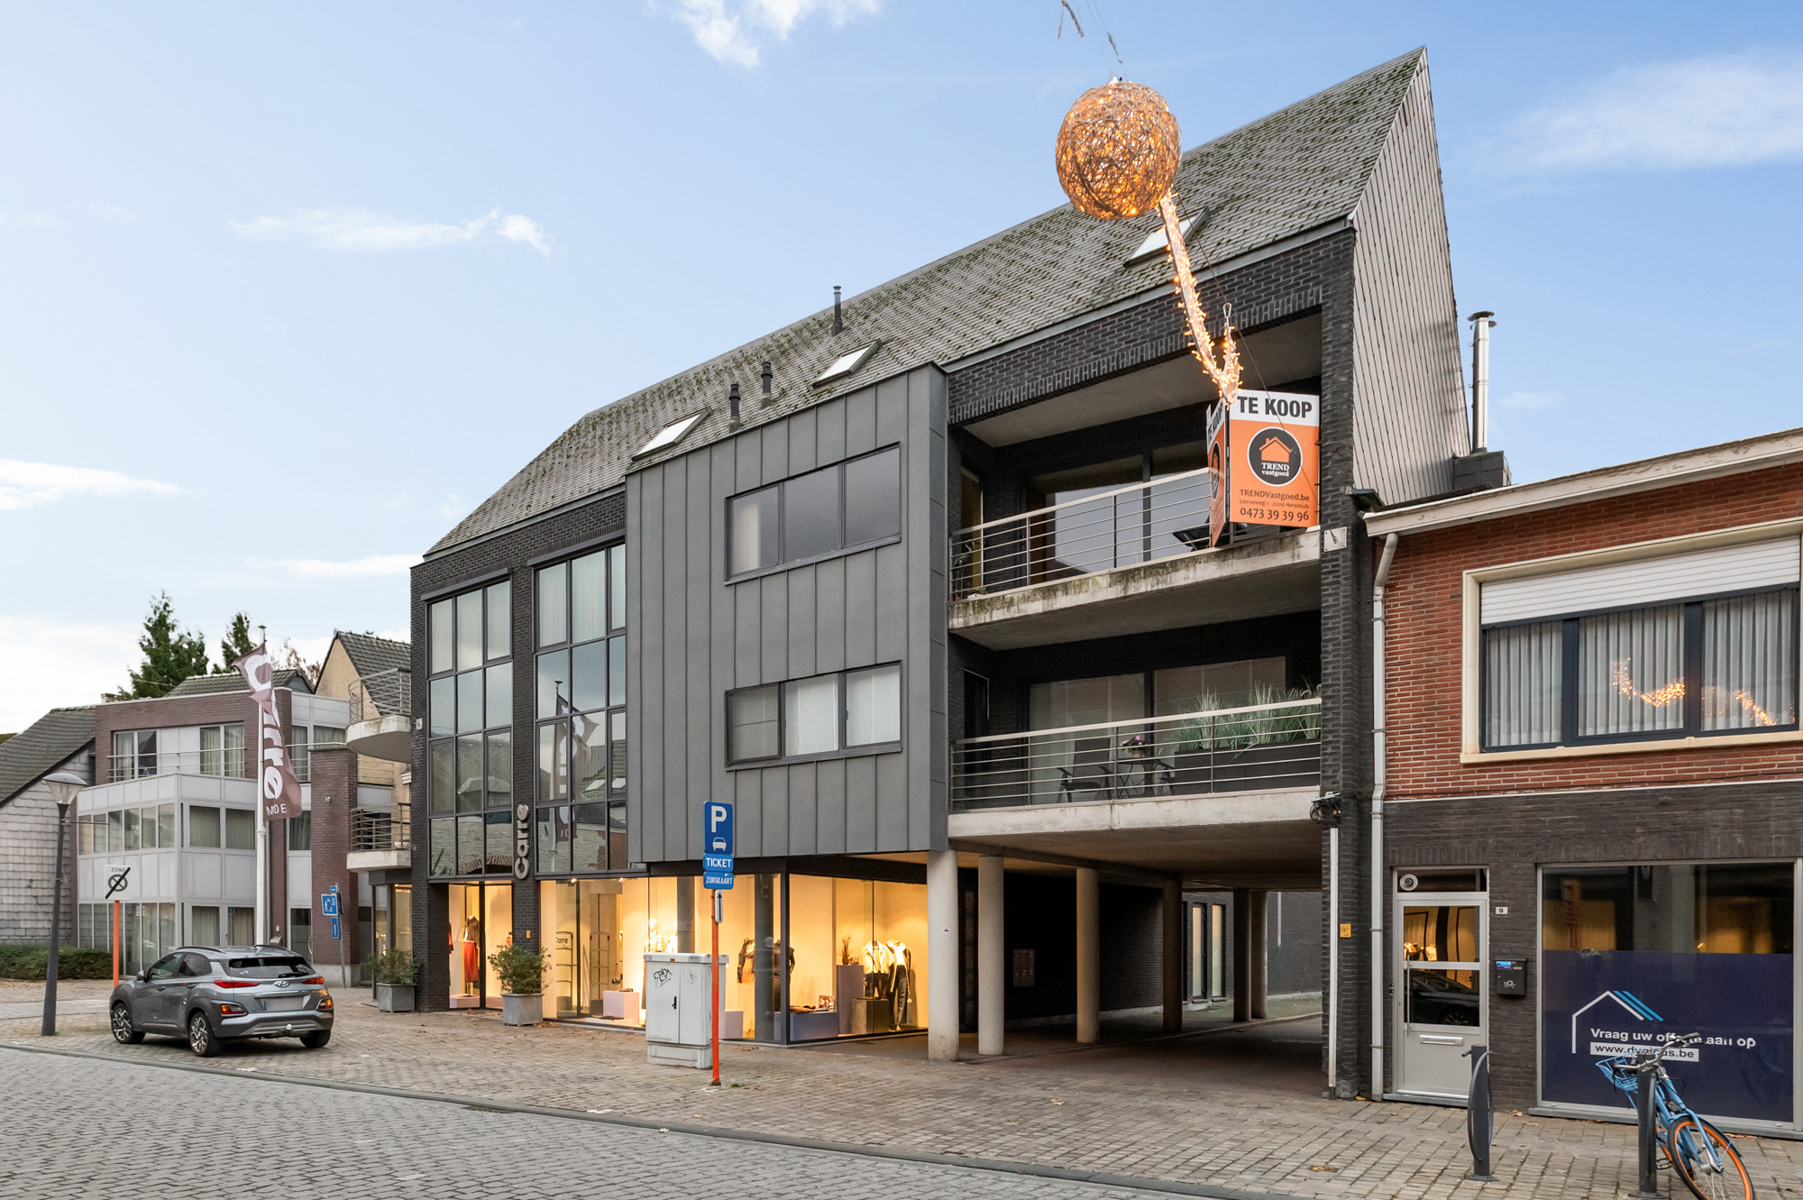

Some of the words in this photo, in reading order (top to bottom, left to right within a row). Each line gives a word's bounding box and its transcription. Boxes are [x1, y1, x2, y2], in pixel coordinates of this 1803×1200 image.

[1237, 396, 1258, 414] TE
[1265, 398, 1312, 419] KOOP
[1261, 462, 1290, 471] TREND
[1261, 469, 1289, 477] vastgoed
[1239, 489, 1310, 501] TRENDVastgoed.be
[1240, 507, 1265, 519] 0473
[1267, 509, 1280, 520] 39
[1282, 510, 1294, 521] 39
[1297, 511, 1310, 522] 96
[711, 805, 727, 833] P
[706, 857, 732, 868] TICKET
[706, 876, 733, 885] ZORGKAART
[1590, 1027, 1629, 1042] Vraag
[1633, 1031, 1653, 1041] uw
[1736, 1037, 1757, 1049] op
